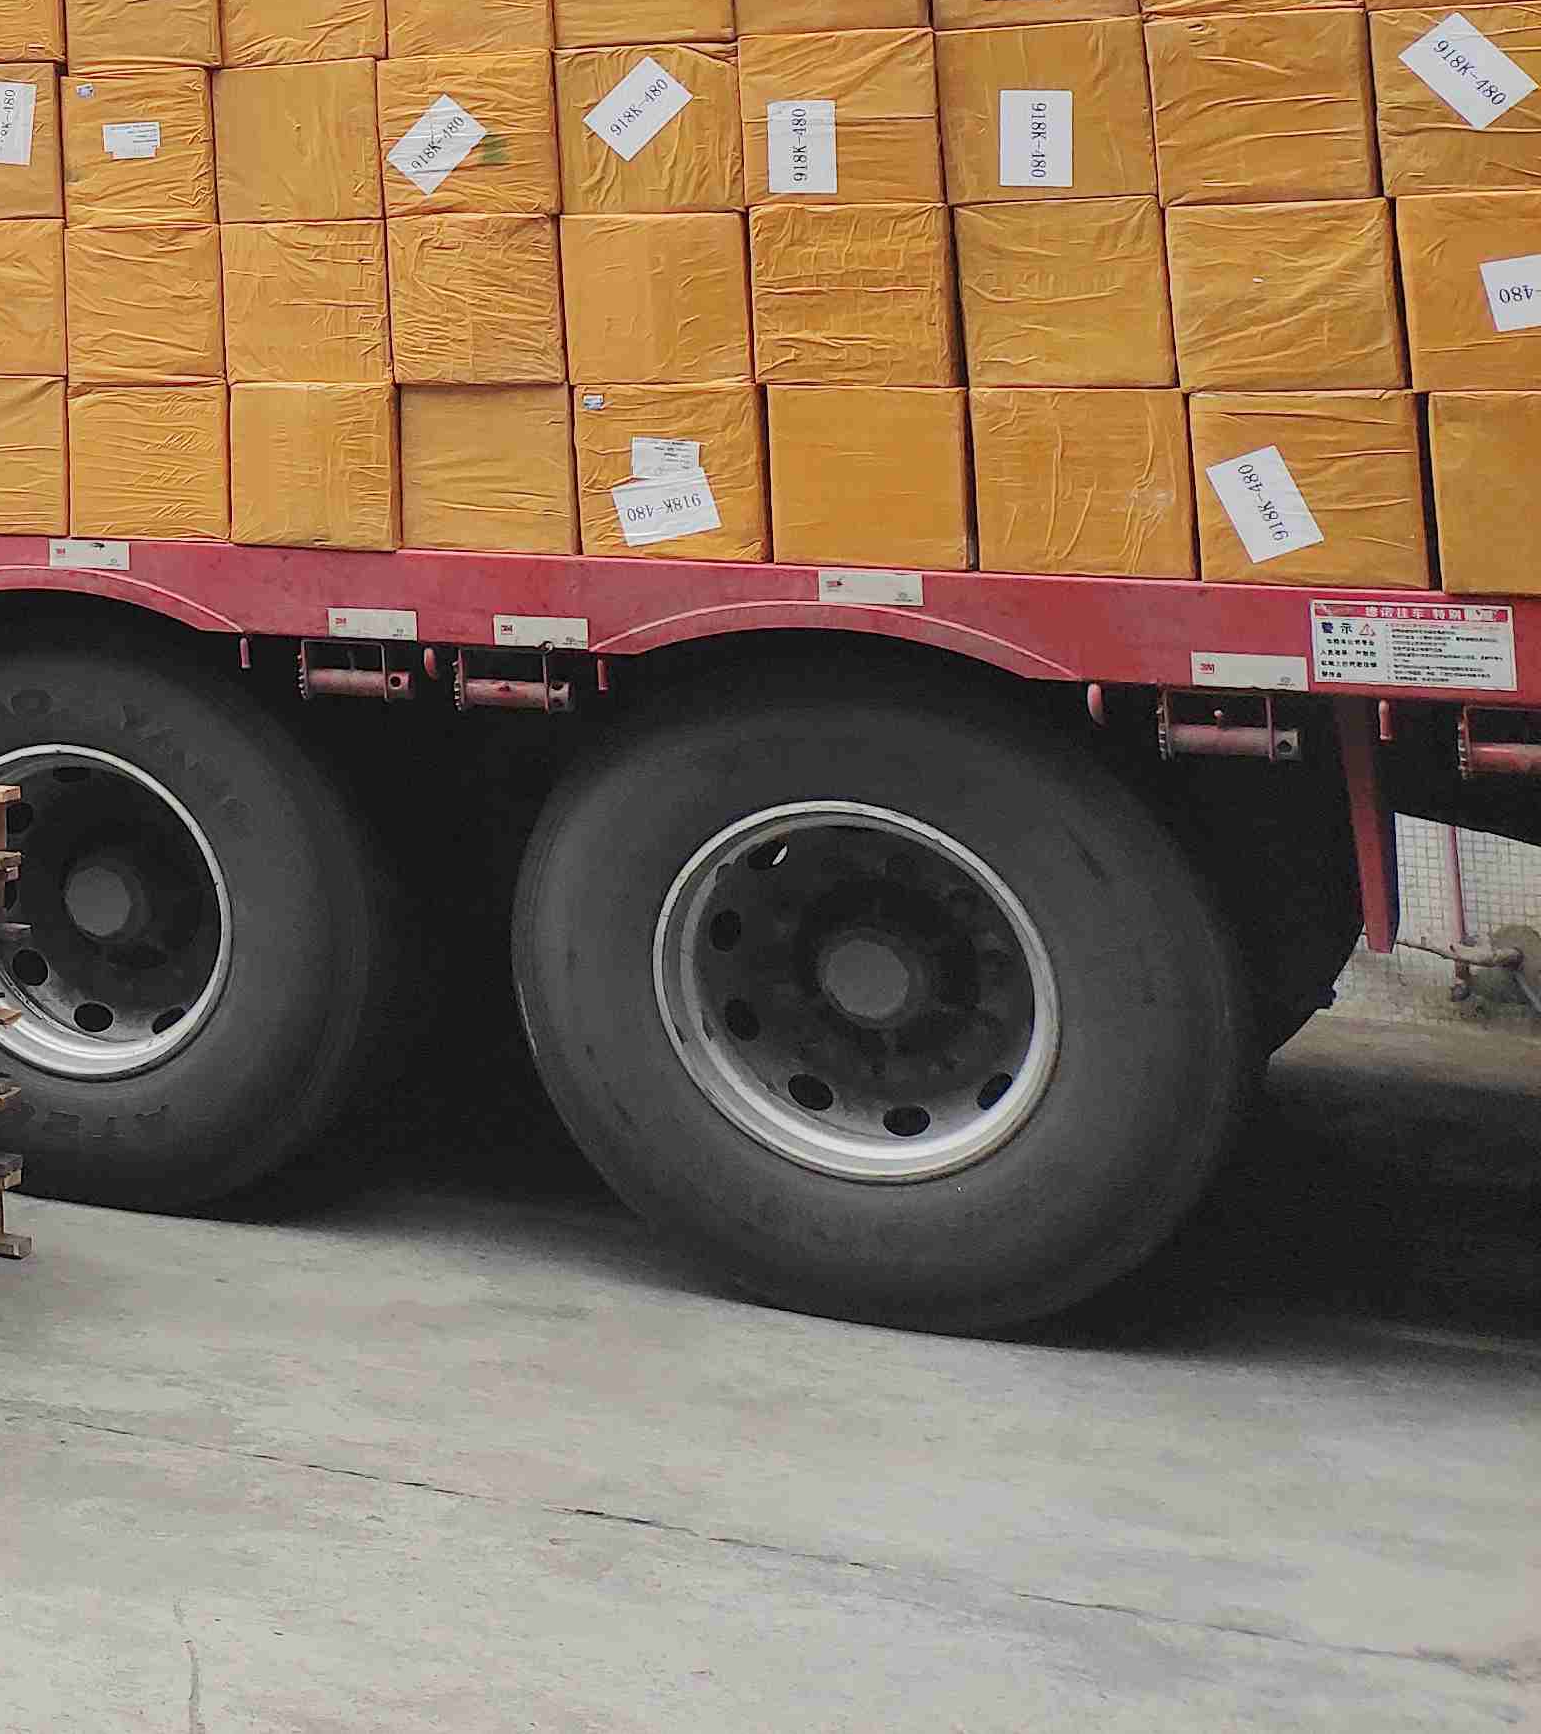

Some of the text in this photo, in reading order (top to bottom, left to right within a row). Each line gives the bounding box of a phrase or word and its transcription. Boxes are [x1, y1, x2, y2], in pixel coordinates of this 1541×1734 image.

[609, 77, 669, 137] 918K-480
[1433, 40, 1507, 107] 918K-480
[411, 115, 465, 172] 918K-480
[791, 107, 808, 182] 918K-480
[1030, 102, 1048, 179] 918K-480
[627, 492, 702, 522] 918K-480
[1237, 464, 1289, 542] 918K-480
